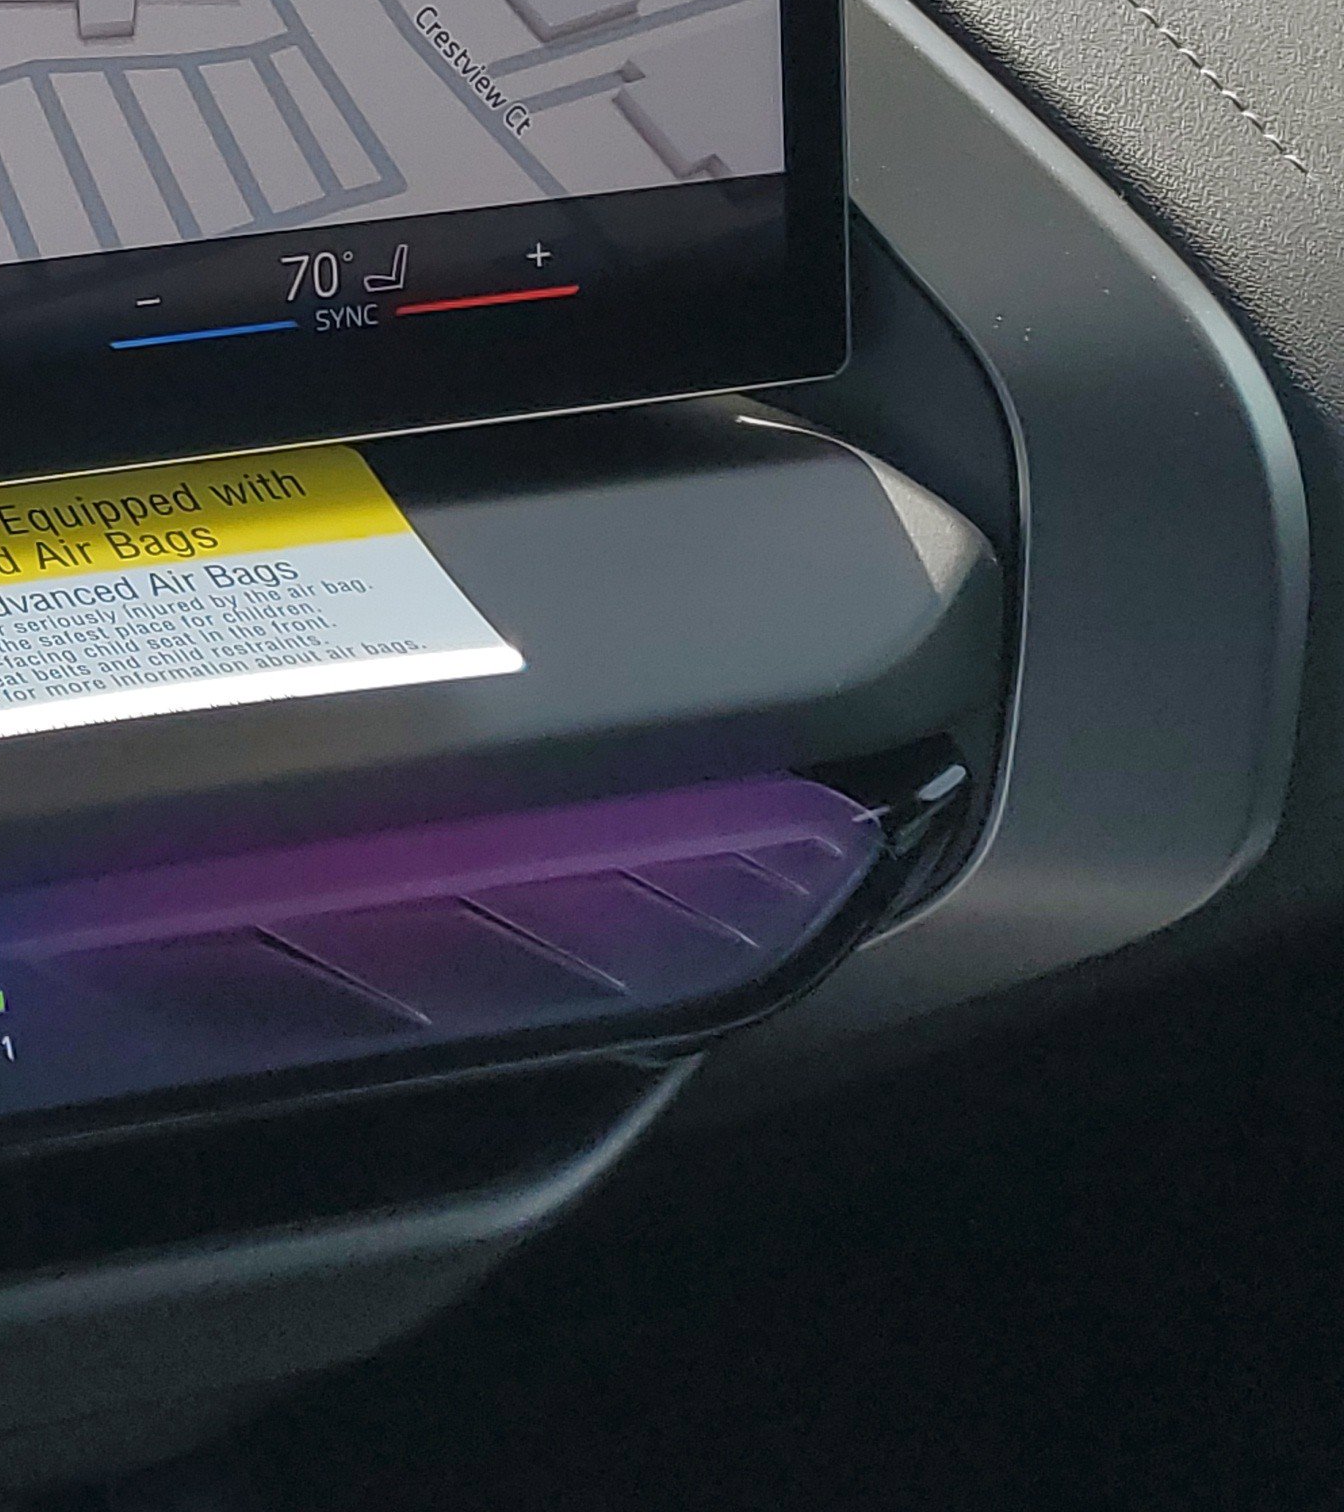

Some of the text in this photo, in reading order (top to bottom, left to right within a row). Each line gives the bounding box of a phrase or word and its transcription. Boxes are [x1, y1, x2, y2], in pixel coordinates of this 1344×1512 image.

[416, 6, 531, 136] Crestview Ct
[314, 303, 380, 334] SYNC
[208, 469, 307, 507] with
[35, 539, 93, 570] Air
[104, 526, 219, 559] Bags
[148, 570, 199, 597] Air
[204, 560, 300, 588] Bags
[14, 609, 116, 634] seriously
[123, 597, 205, 620] injured
[210, 594, 238, 609] by
[244, 590, 281, 605] the
[287, 583, 316, 598] air
[321, 578, 373, 595] bag.
[39, 627, 110, 647] safest
[115, 619, 176, 640] place
[181, 614, 214, 629] for
[223, 601, 322, 624] children.
[31, 663, 92, 682] belts
[98, 655, 141, 673] and
[148, 647, 204, 666] child
[212, 634, 330, 658] restraints.
[84, 639, 140, 658] child
[146, 632, 197, 650] seat
[199, 629, 224, 643] in
[228, 625, 267, 640] the
[271, 614, 337, 635] front.
[2, 688, 37, 702] for
[45, 674, 106, 697] more
[110, 659, 250, 688] information
[254, 650, 322, 669] about
[325, 644, 357, 660] air
[361, 638, 428, 654] bags.
[0, 1035, 15, 1062] 1
